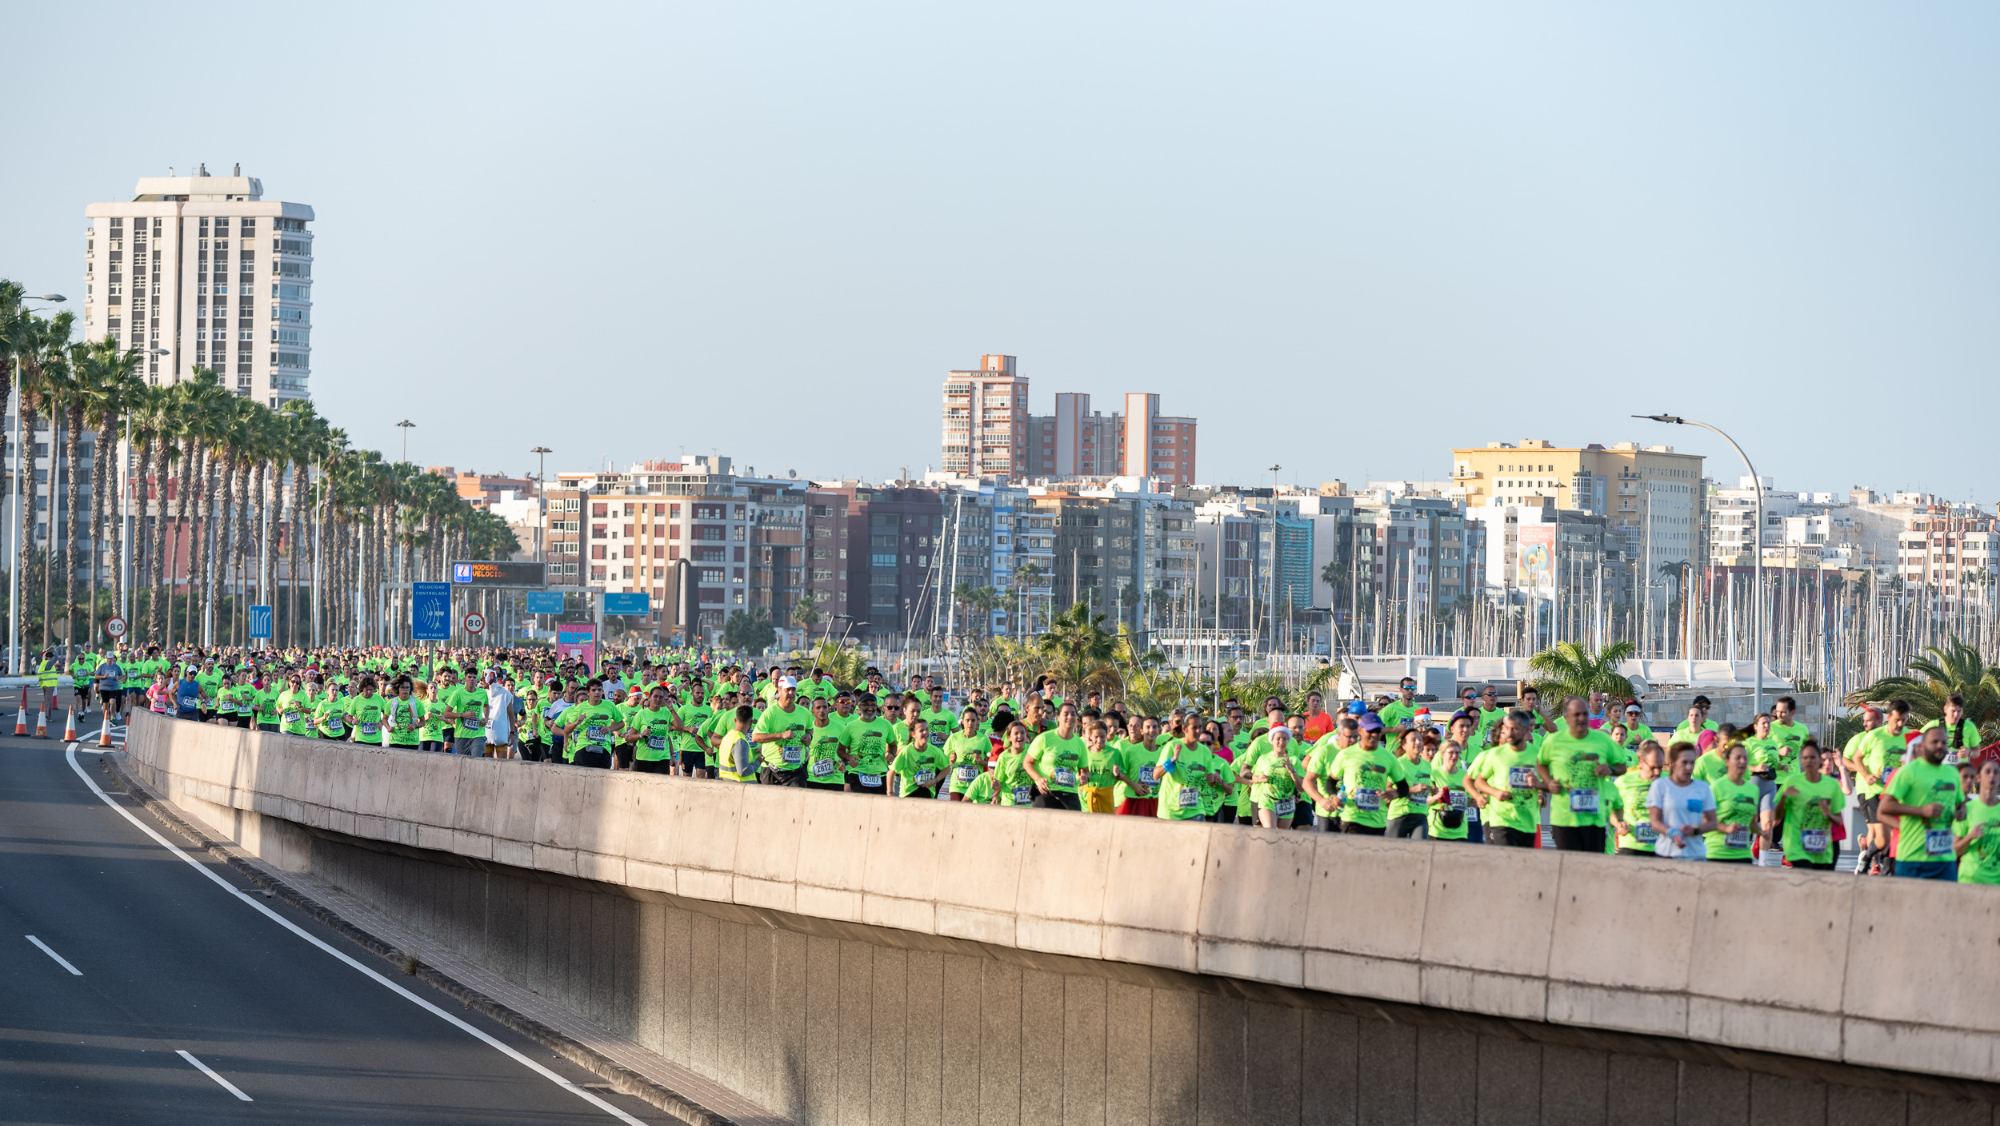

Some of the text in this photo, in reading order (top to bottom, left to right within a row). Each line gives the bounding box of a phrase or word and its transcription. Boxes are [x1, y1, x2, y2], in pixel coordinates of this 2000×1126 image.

[110, 623, 123, 632] 80
[467, 619, 482, 627] 80
[816, 762, 831, 774] 2812
[961, 769, 976, 778] 6163
